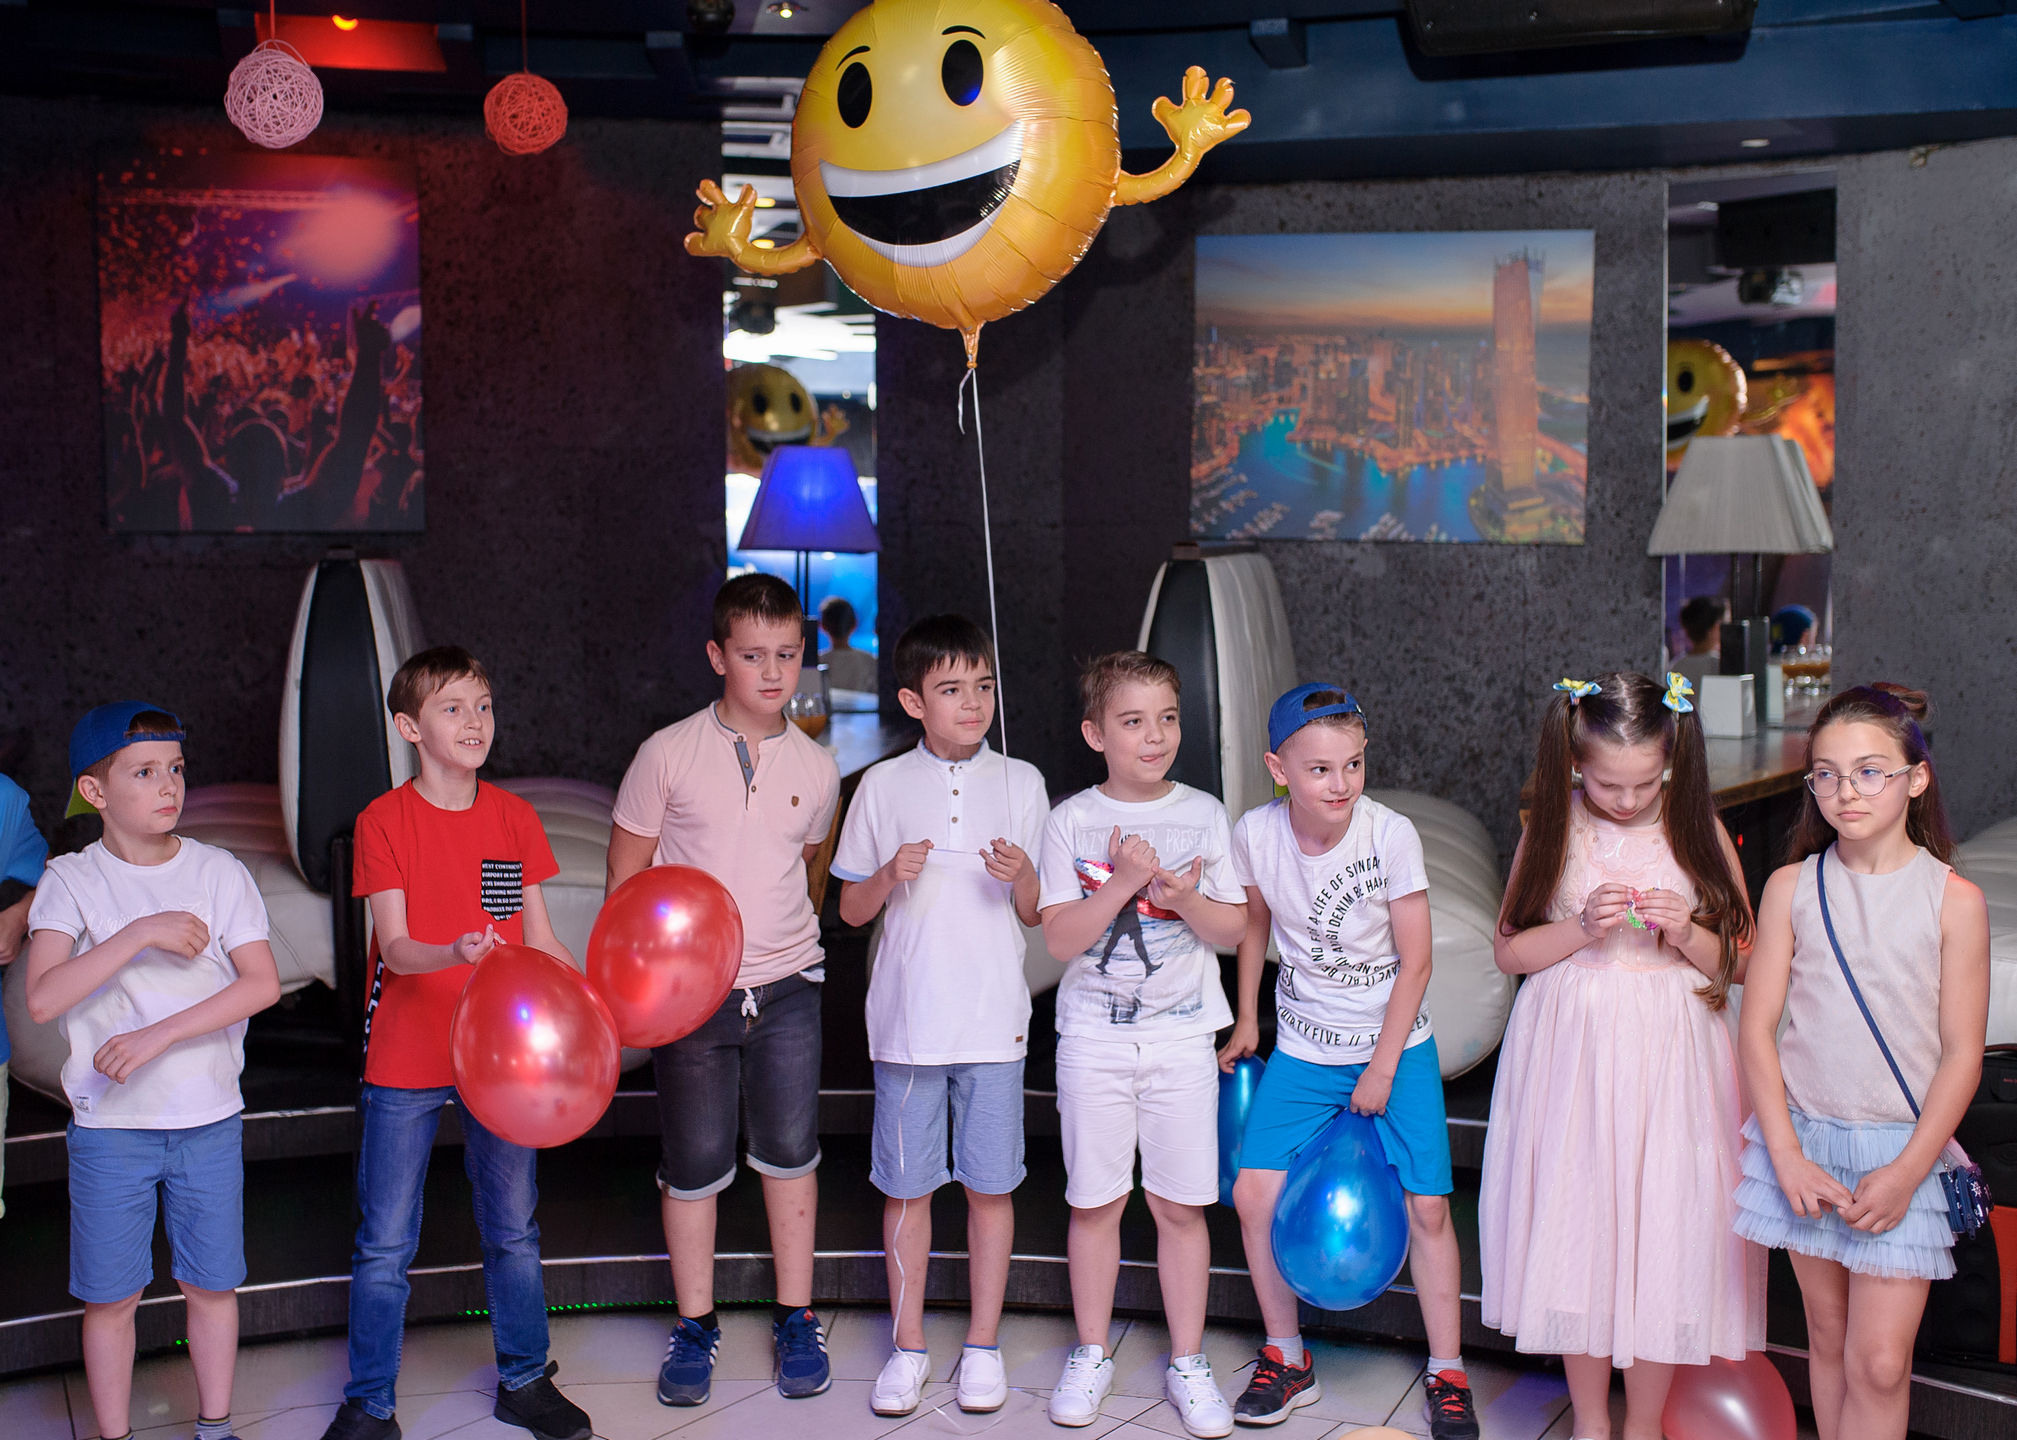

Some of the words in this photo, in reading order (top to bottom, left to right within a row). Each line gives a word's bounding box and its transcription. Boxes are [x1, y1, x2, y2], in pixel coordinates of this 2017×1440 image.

[1311, 889, 1333, 917] LIFE
[1329, 873, 1344, 892] OF
[1328, 892, 1356, 927] DENIM
